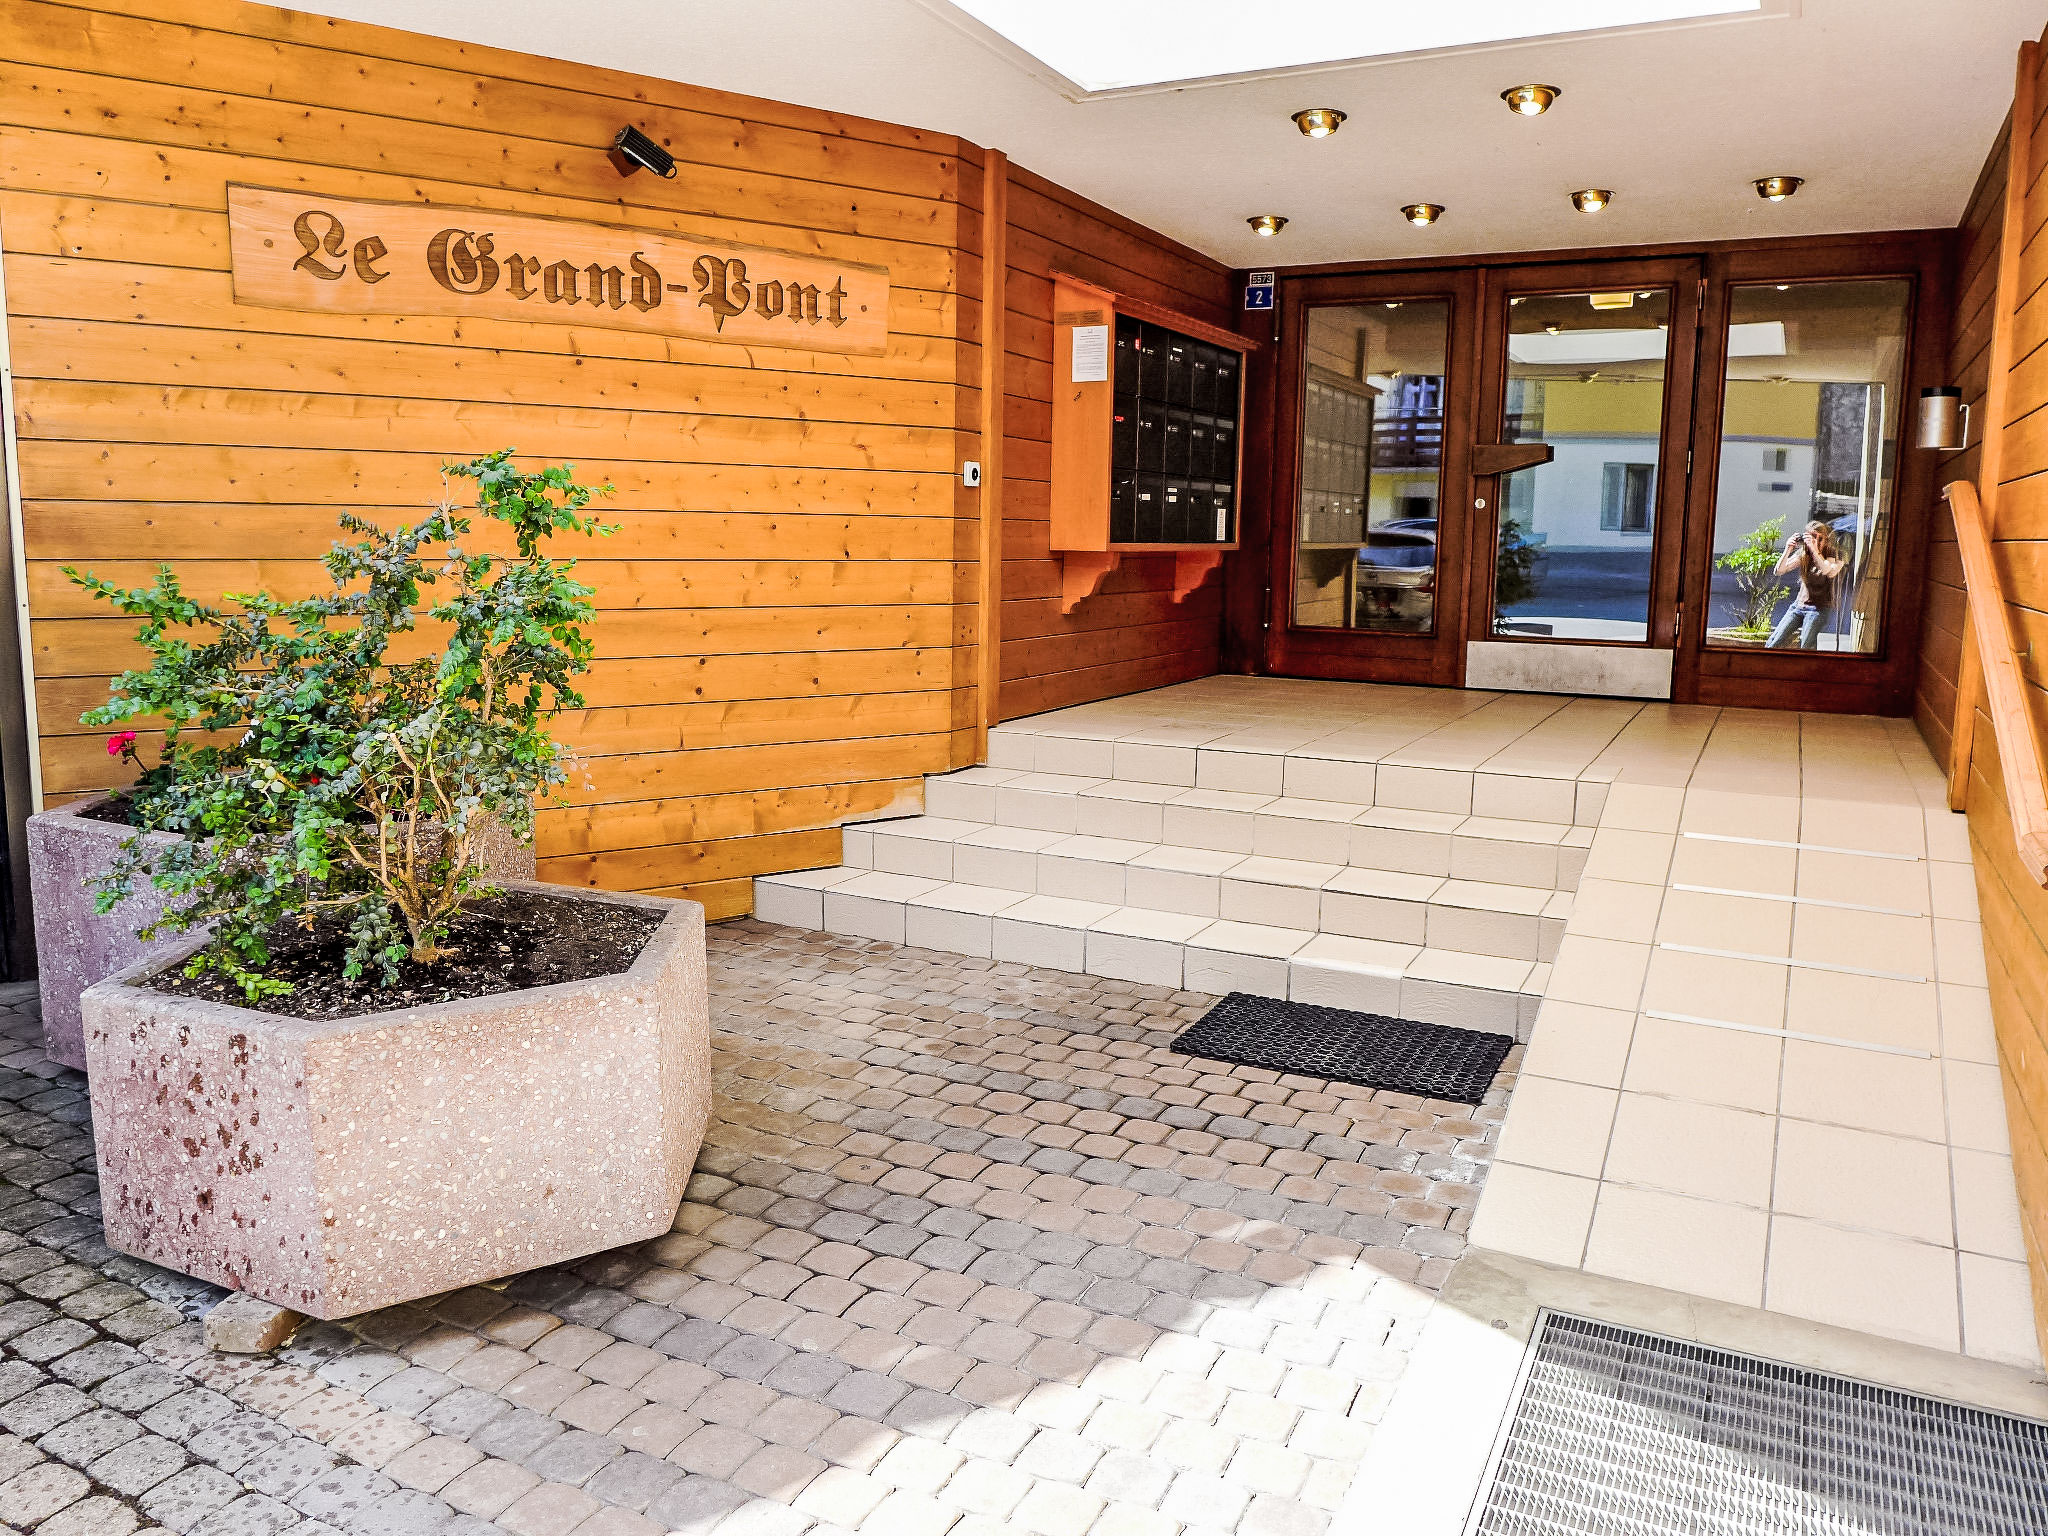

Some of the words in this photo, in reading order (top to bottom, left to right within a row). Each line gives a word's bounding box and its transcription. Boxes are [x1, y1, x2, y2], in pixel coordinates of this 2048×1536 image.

[293, 210, 391, 284] Le
[426, 228, 848, 333] Grand-Pont
[1252, 274, 1272, 284] 5573
[1255, 290, 1263, 304] 2
